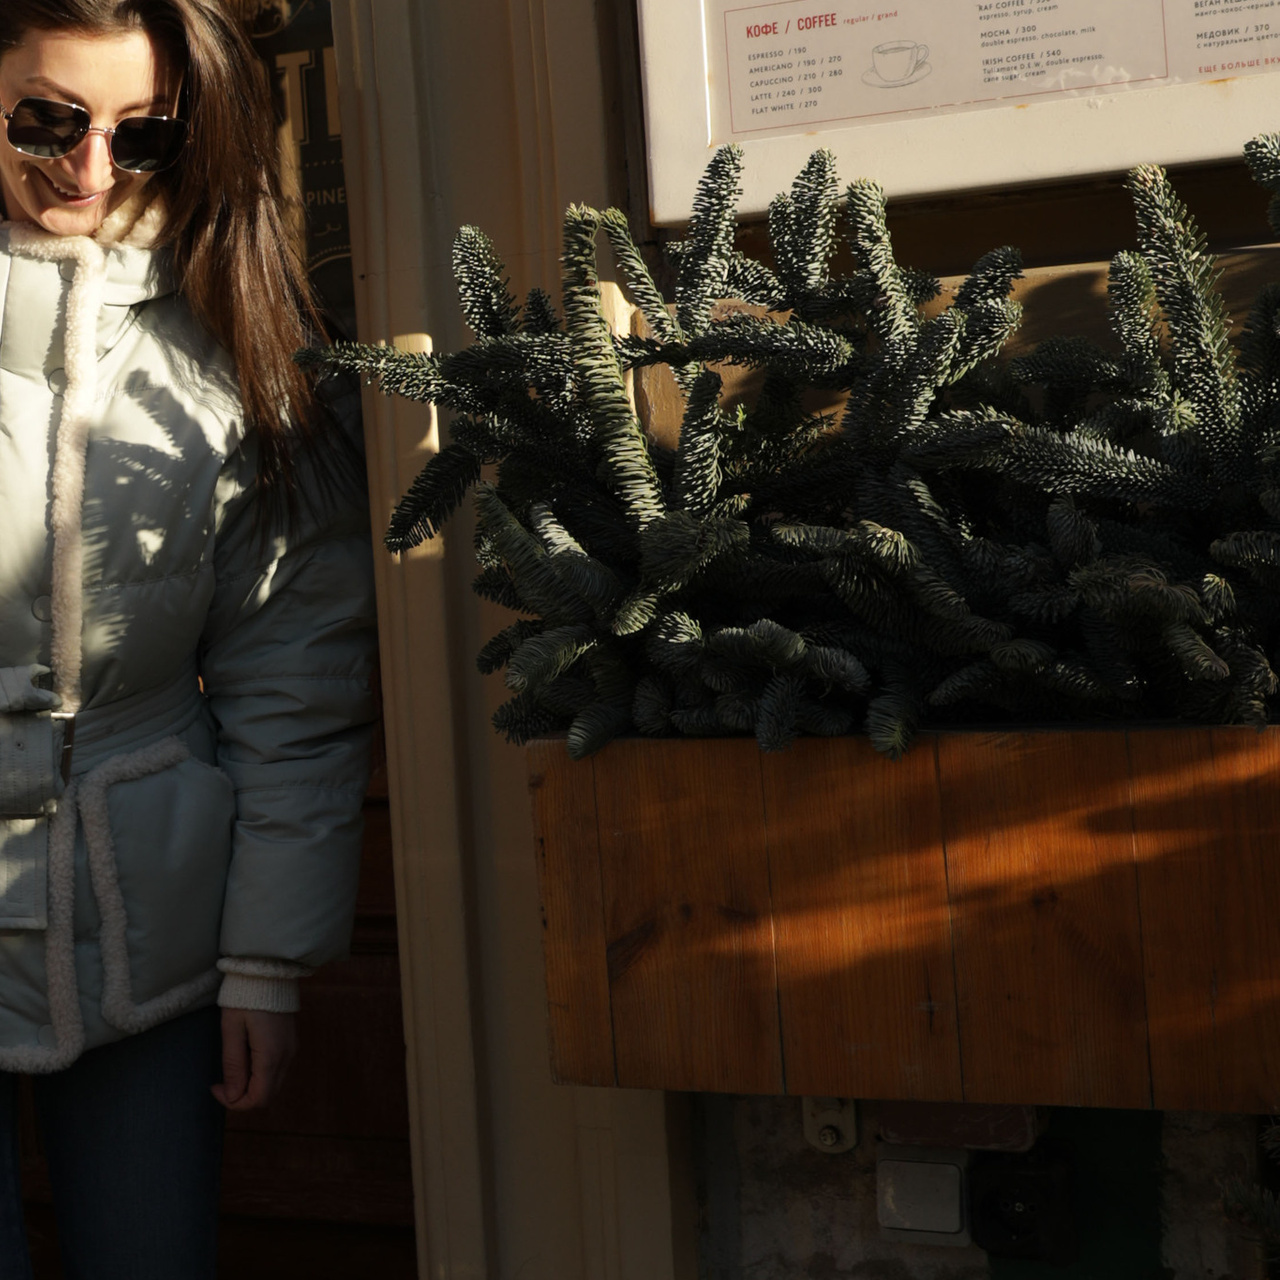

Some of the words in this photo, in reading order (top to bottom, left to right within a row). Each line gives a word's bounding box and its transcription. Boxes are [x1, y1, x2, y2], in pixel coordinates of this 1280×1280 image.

[977, 3, 993, 11] RAF
[995, 0, 1024, 10] COFFEE
[746, 22, 779, 39] КОФЕ
[797, 13, 837, 31] COFFEE
[980, 29, 1010, 38] MOCHA
[1022, 25, 1037, 33] 300
[1196, 28, 1239, 39] МЕДОВИК
[1254, 23, 1270, 32] 370
[748, 50, 784, 61] ESPRESSO
[794, 46, 807, 54] 190
[982, 57, 1003, 66] IRISH
[1005, 52, 1035, 63] COFFEE
[1046, 49, 1062, 58] 540
[749, 62, 793, 74] AMERICANO
[828, 55, 842, 63] 270
[749, 76, 794, 88] CAPUCCINO
[803, 72, 816, 81] 210
[829, 69, 843, 77] 280
[751, 92, 772, 102] LATTE
[782, 89, 796, 97] 240
[808, 85, 822, 94] 300
[751, 106, 768, 115] FLAT
[770, 103, 794, 112] WHITE
[804, 100, 818, 108] 270
